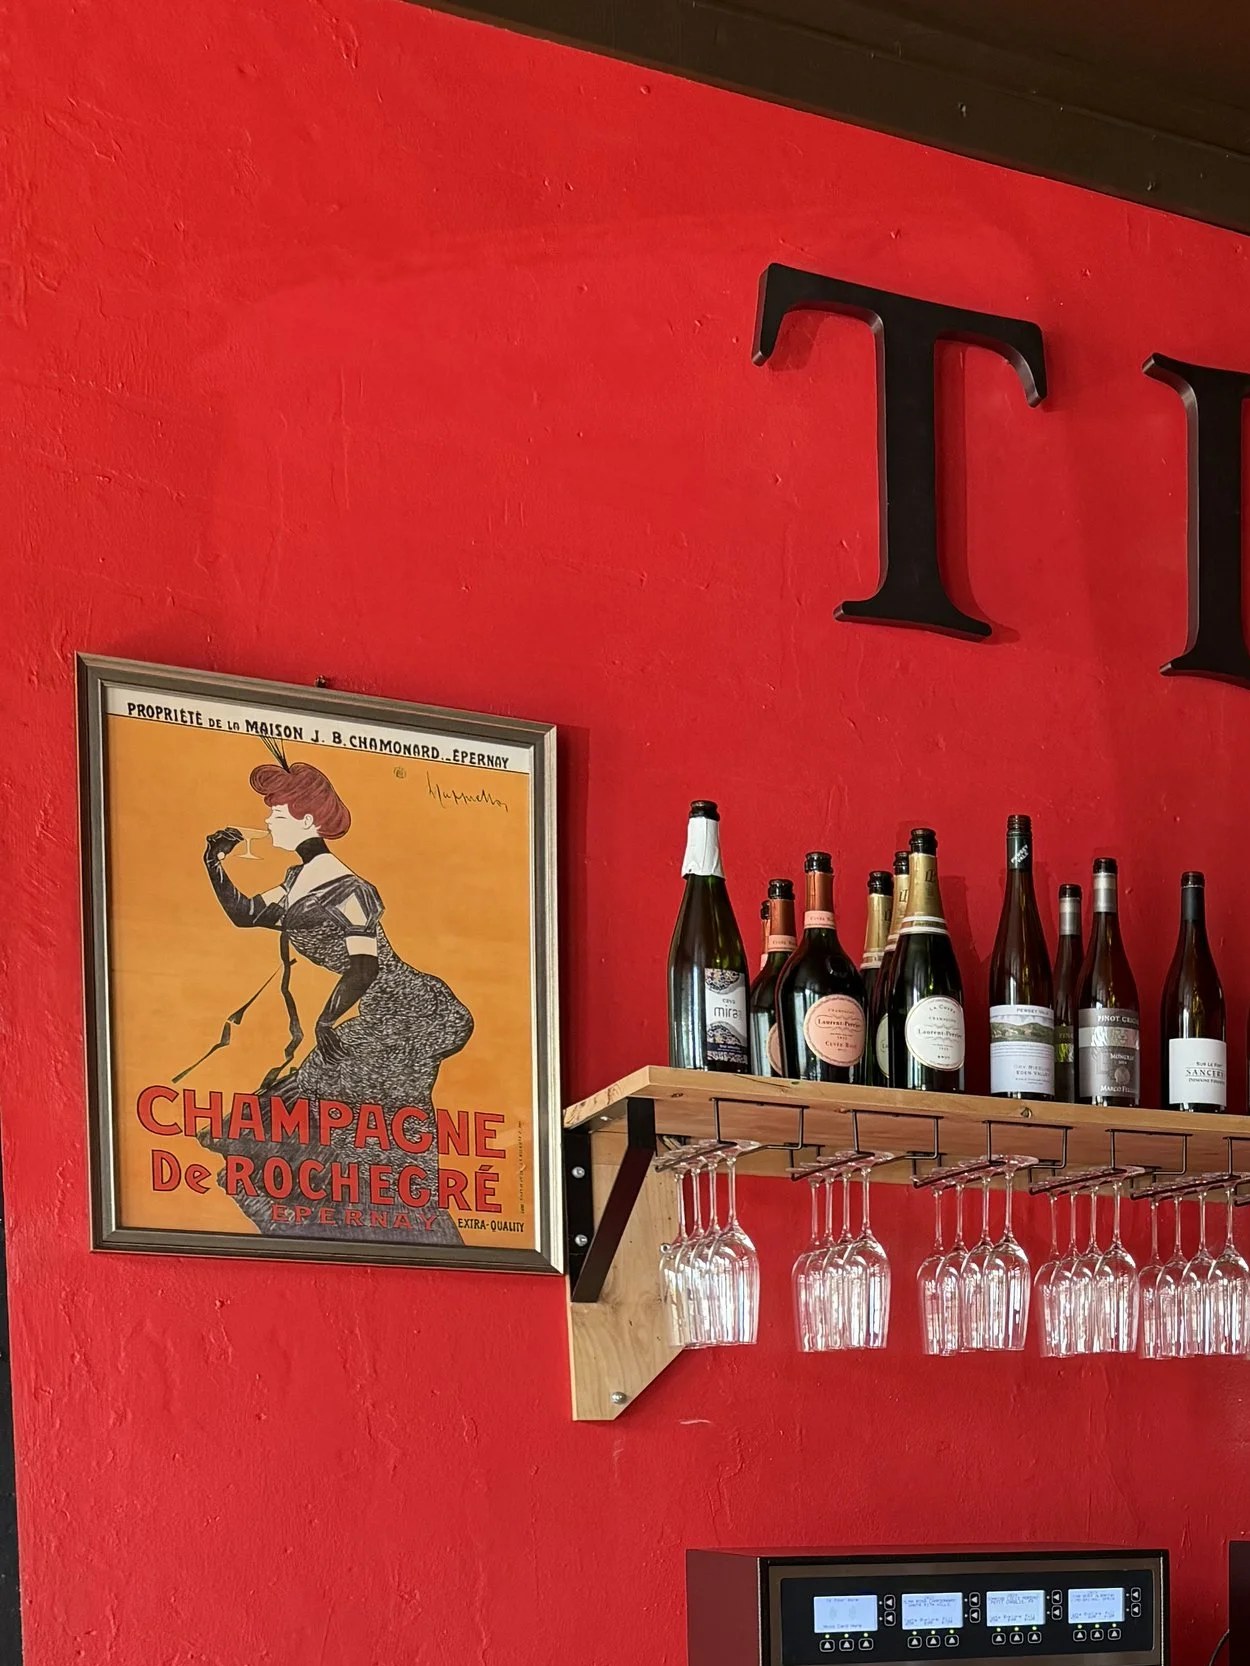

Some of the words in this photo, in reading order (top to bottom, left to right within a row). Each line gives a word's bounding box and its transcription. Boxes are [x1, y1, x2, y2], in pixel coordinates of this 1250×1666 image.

[208, 717, 223, 729] DE
[245, 719, 304, 741] MAISON
[332, 731, 347, 747] B.
[1097, 1015, 1120, 1023] PINOT
[136, 1084, 507, 1160] CHAMPAGNE
[151, 1148, 213, 1196] De
[225, 1154, 503, 1215] ROCHEGRÉ
[271, 1203, 439, 1232] EPERNAY
[457, 1217, 525, 1234] EXTRA-QUALITY
